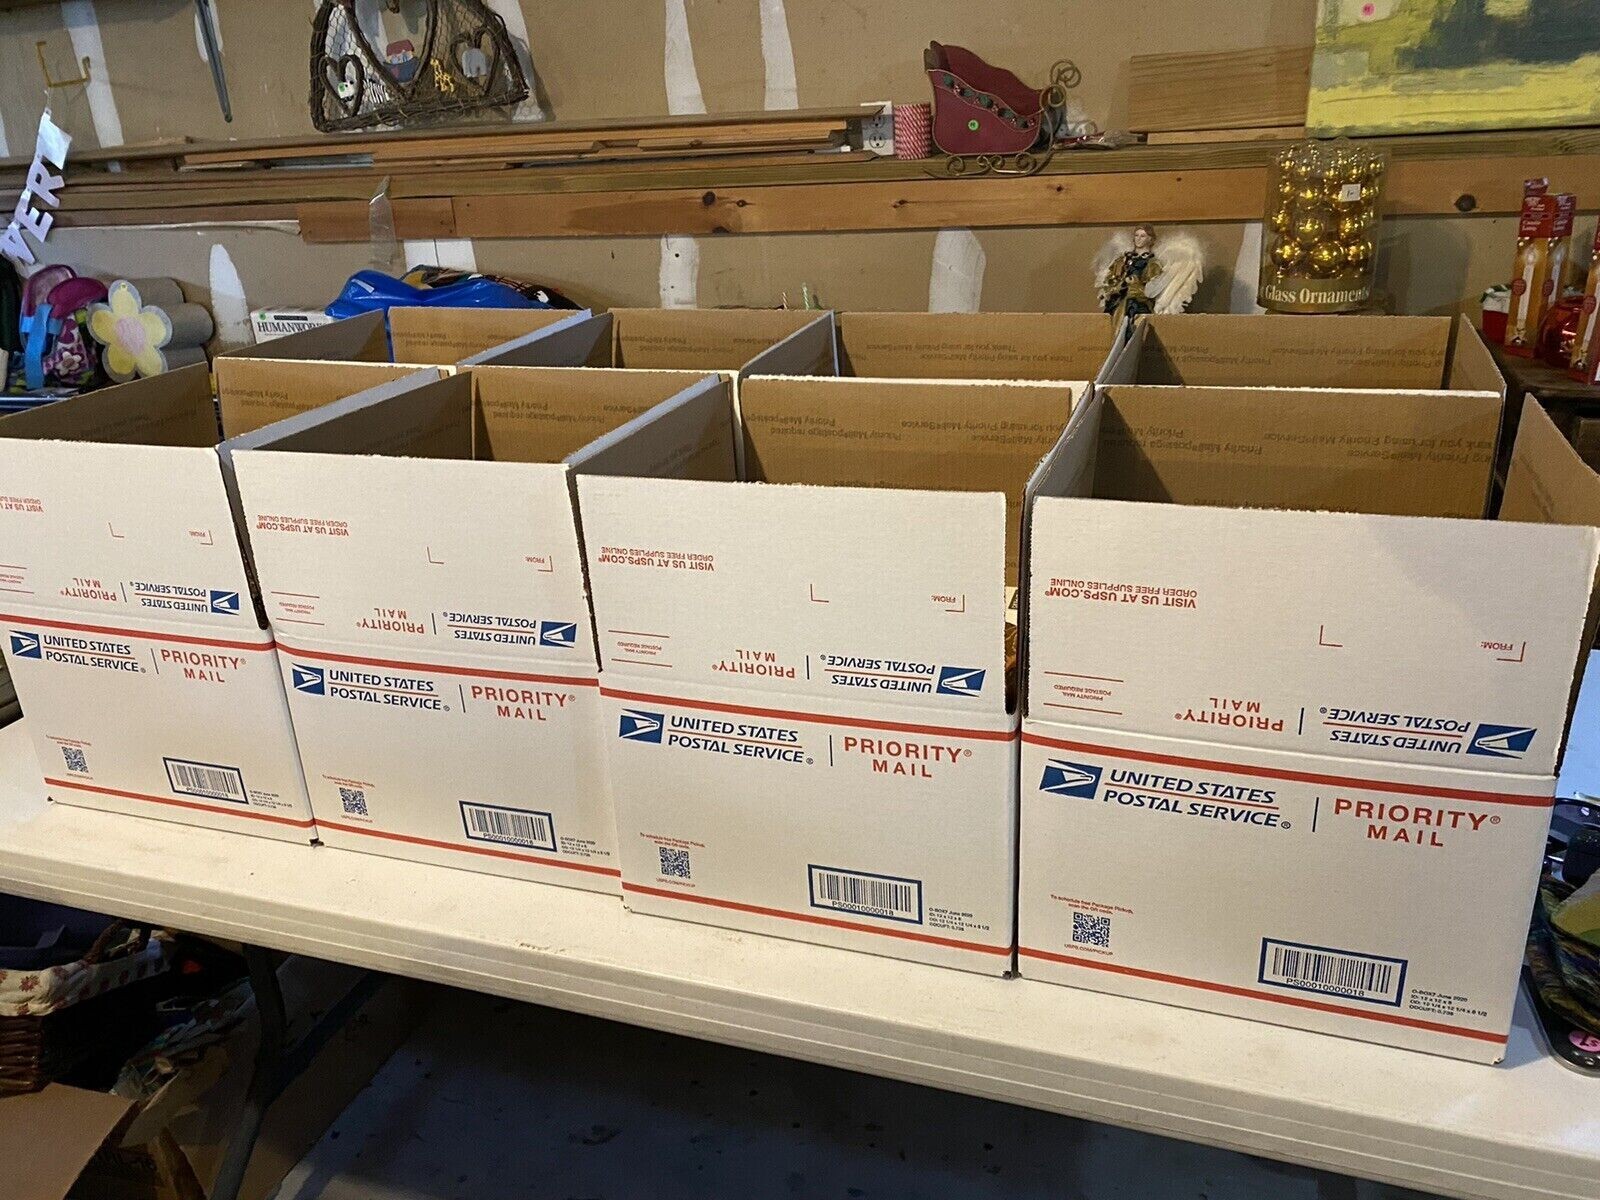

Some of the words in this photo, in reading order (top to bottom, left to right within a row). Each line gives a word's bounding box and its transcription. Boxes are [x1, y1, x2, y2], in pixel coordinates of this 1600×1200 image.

[1265, 284, 1297, 303] Glass
[1225, 443, 1262, 455] Priority
[601, 547, 628, 555] ONLINE
[629, 549, 665, 558] SUPPLIES
[657, 559, 669, 567] AT
[672, 560, 686, 568] US
[689, 562, 714, 571] VISIT
[73, 578, 101, 588] MAIL
[1051, 578, 1085, 588] ONLINE
[1087, 581, 1133, 592] SUPPLIES
[172, 586, 206, 597] POSTAL
[1135, 586, 1160, 594] FREE
[1163, 588, 1197, 597] ORDER
[141, 598, 172, 609] STATES
[1121, 594, 1138, 603] AT
[1141, 595, 1159, 605] US
[1163, 597, 1196, 608] VISIT
[173, 602, 208, 612] UNITED
[374, 608, 406, 619] MAIL
[495, 617, 536, 628] POSTAL
[455, 630, 492, 641] STATES
[494, 634, 535, 645] UNITED
[44, 635, 87, 649] UNITED
[89, 641, 131, 655] STATES
[1481, 642, 1513, 650] FROM:
[46, 651, 89, 666] POSTAL
[736, 650, 775, 662] MAIL
[885, 661, 935, 674] POSTAL
[184, 668, 225, 682] MAIL
[330, 670, 381, 685] UNITED
[384, 677, 433, 691] STATES
[832, 675, 878, 688] STATES
[880, 680, 932, 693] UNITED
[331, 687, 381, 703] POSTAL
[1210, 698, 1260, 713] MAIL
[497, 705, 546, 721] MAIL
[671, 716, 734, 734] UNITED
[737, 725, 798, 742] STATES
[1404, 716, 1471, 732] POSTAL
[668, 735, 729, 753] POSTAL
[1330, 730, 1391, 746] STATES
[1393, 737, 1461, 753] UNITED
[873, 759, 932, 778] MAIL
[1110, 769, 1193, 792] UNITED
[1196, 782, 1276, 803] STATES
[1103, 790, 1182, 813] POSTAL
[1367, 825, 1443, 847] MAIL
[1286, 978, 1364, 997] PS00010000018
